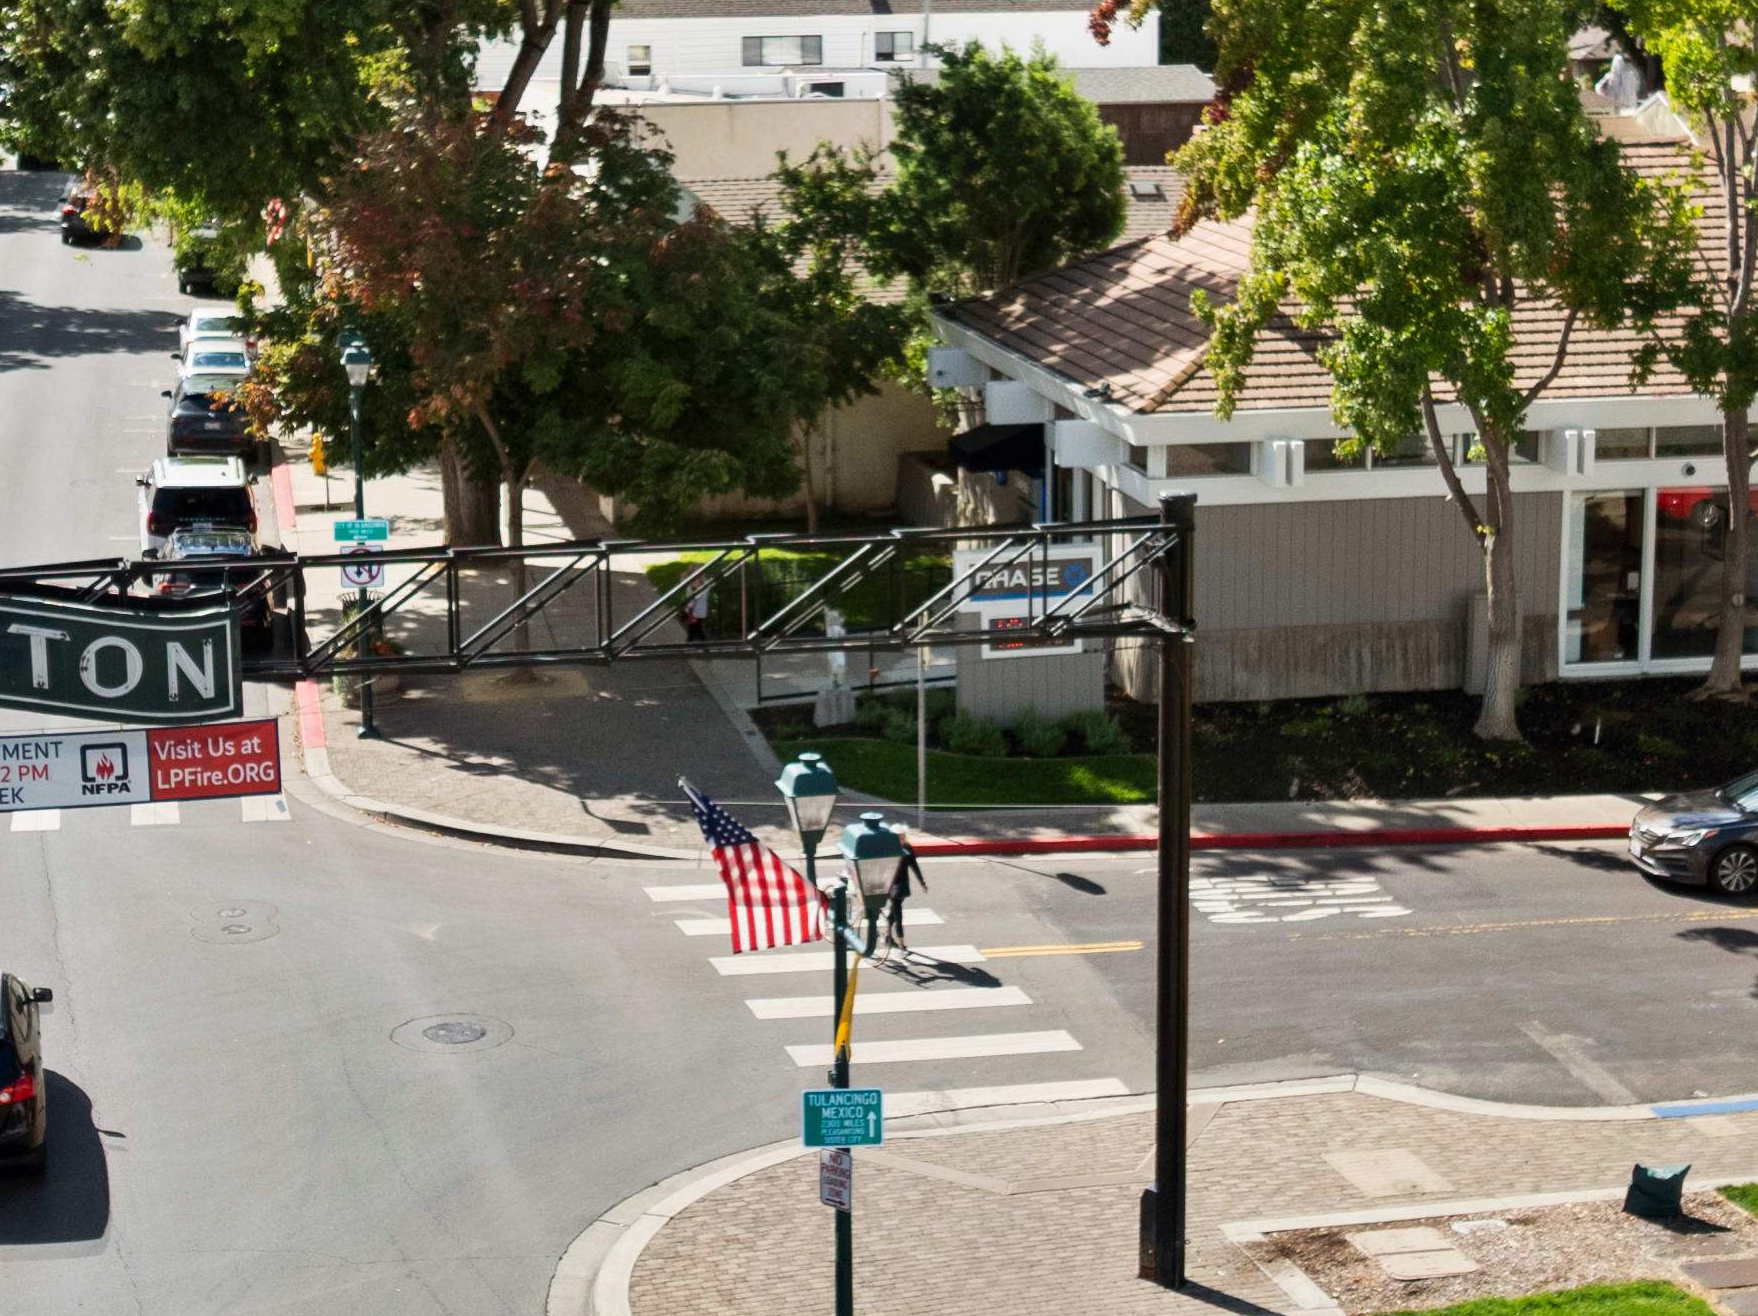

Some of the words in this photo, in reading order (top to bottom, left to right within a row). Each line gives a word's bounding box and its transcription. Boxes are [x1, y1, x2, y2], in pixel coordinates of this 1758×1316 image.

[975, 567, 1060, 589] CHASE
[154, 740, 203, 761] Visit
[207, 737, 236, 757] Us
[240, 736, 262, 754] at
[18, 764, 50, 782] PM
[157, 761, 276, 790] LPFire.ORG
[82, 781, 131, 796] NFPA
[808, 1092, 877, 1106] TULANCINGO
[822, 1106, 863, 1119] MEXICO
